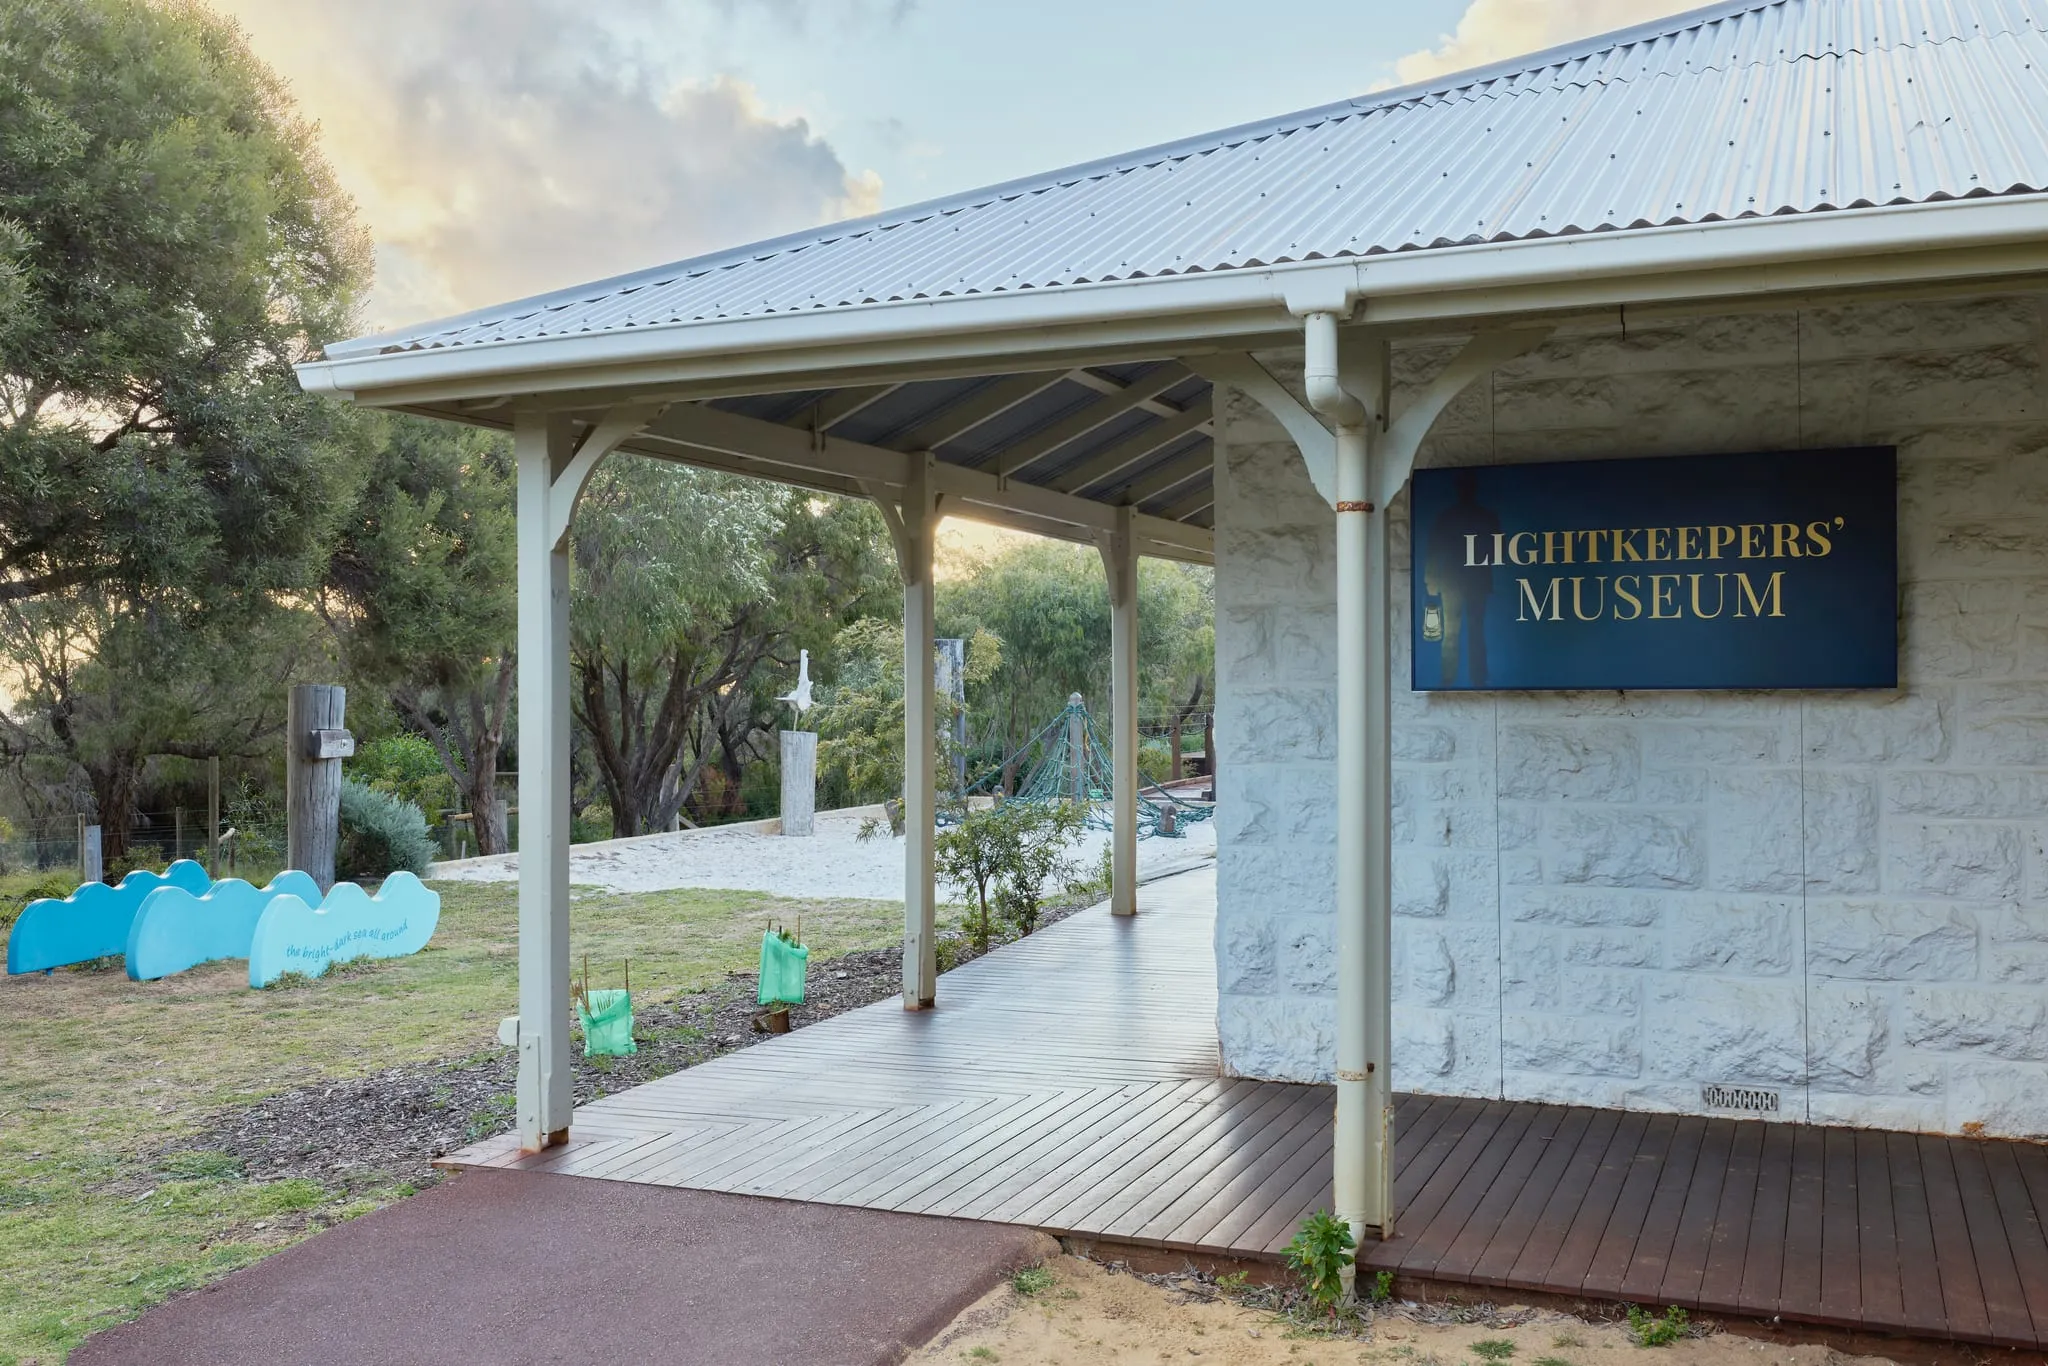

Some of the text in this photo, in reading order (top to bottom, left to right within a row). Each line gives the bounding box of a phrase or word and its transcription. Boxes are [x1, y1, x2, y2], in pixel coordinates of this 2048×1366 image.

[1515, 571, 1787, 622] MUSEUM
[287, 945, 300, 957] the
[353, 928, 367, 940] sea
[369, 928, 381, 940] all
[381, 918, 408, 941] around
